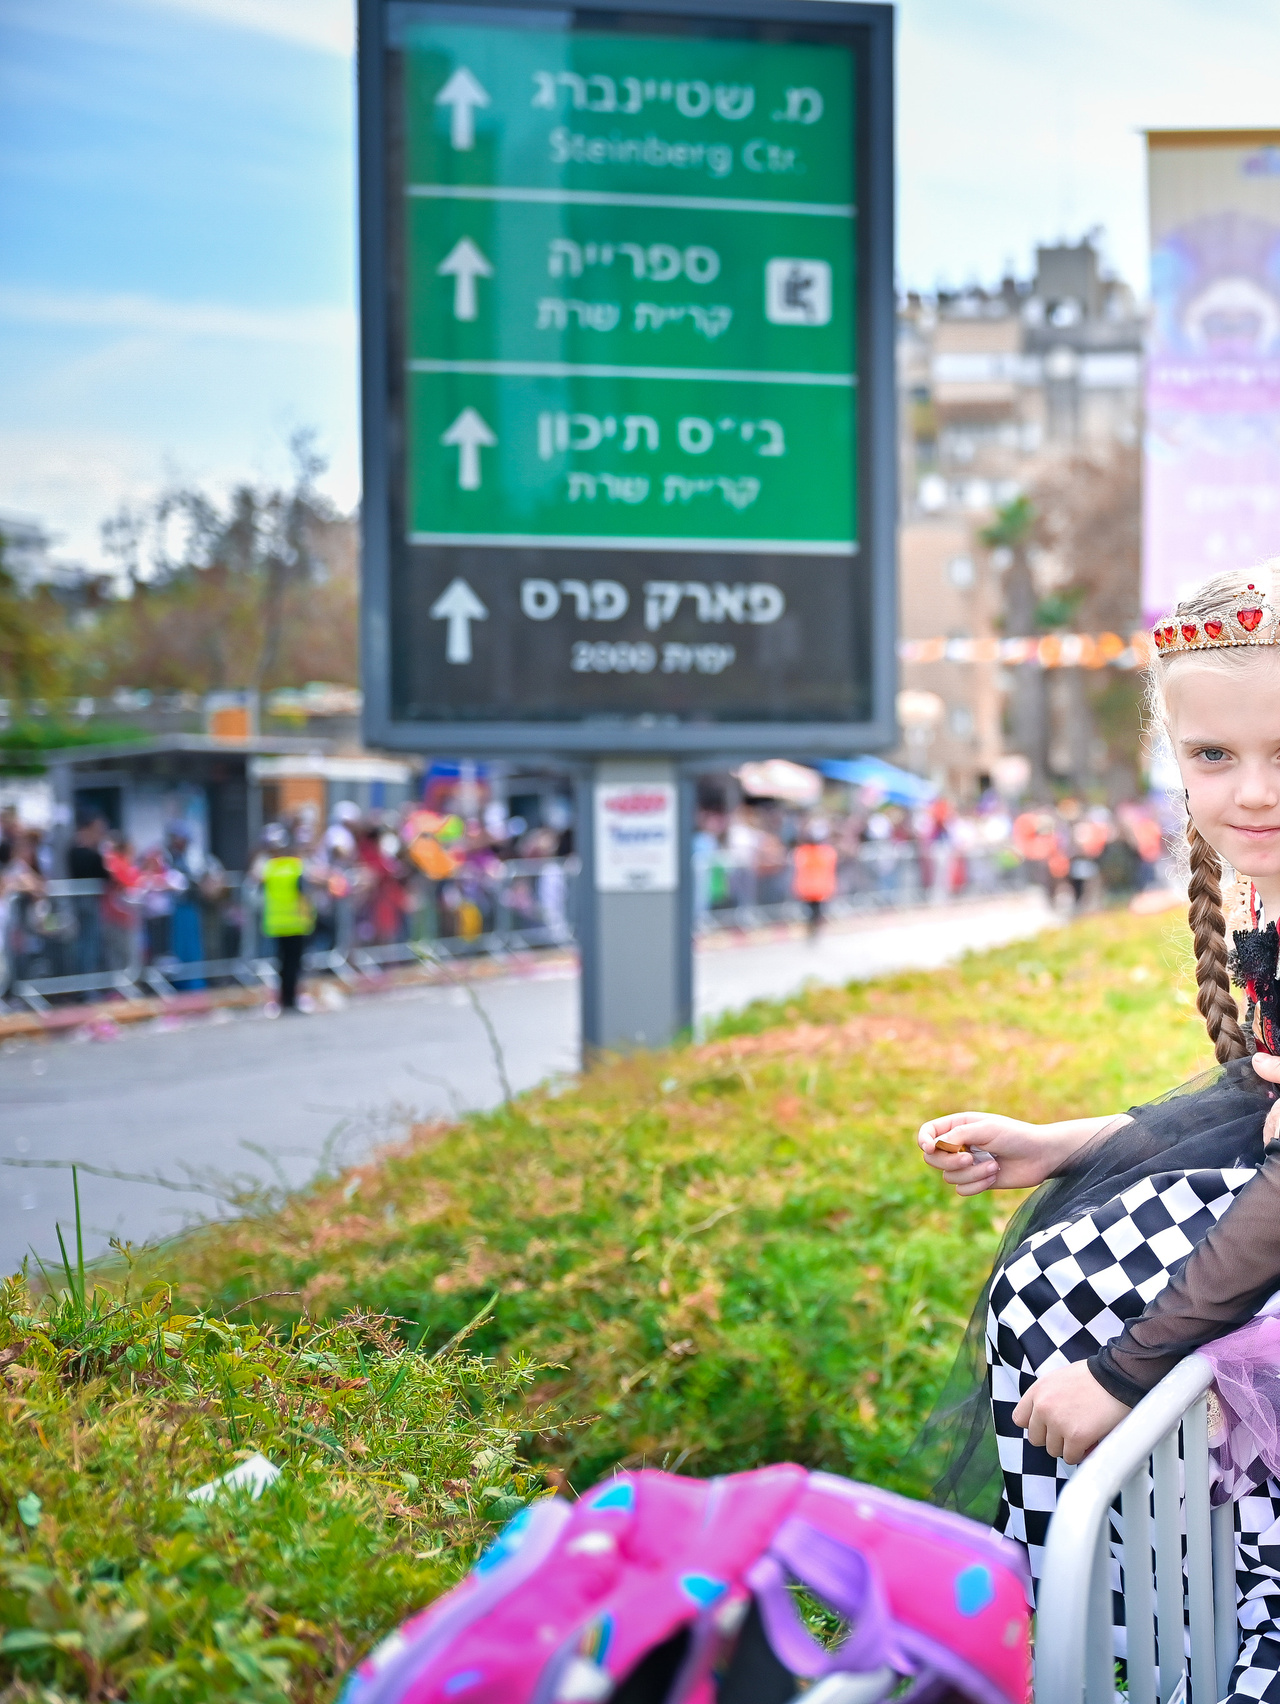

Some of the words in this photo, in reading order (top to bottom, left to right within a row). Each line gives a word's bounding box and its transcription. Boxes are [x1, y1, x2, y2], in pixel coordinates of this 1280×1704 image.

[531, 70, 755, 120] שטיינברג
[771, 86, 825, 125] מ.
[548, 127, 733, 177] Steinberg
[548, 239, 721, 284] ספרייה
[536, 298, 619, 332] שרת
[631, 302, 734, 340] קריית
[537, 410, 660, 461] תיכון
[567, 472, 651, 504] שרת
[662, 474, 761, 511] קריית
[520, 579, 630, 622] פרס
[642, 581, 785, 631] פארק
